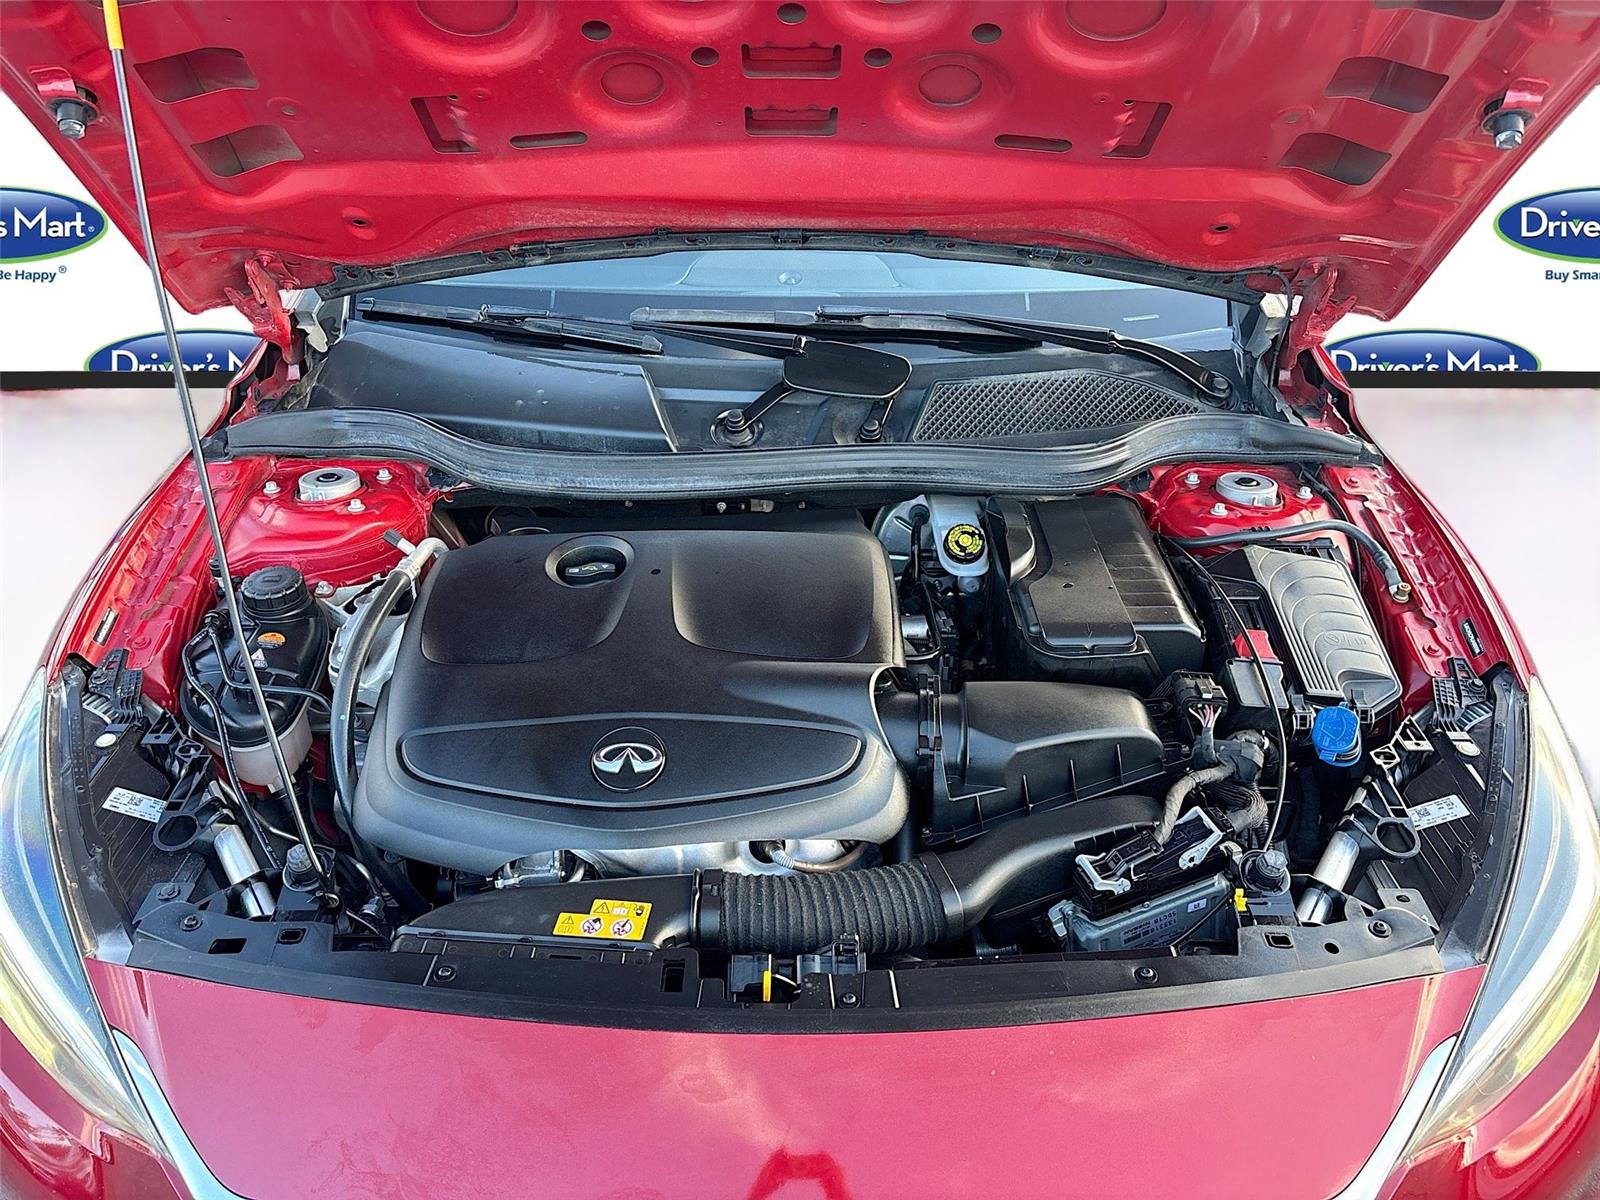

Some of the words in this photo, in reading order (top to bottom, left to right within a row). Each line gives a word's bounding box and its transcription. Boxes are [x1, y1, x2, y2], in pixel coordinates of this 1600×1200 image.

[14, 206, 86, 238] Mart
[1520, 206, 1600, 238] Drive
[1545, 269, 1570, 283] Buy
[1572, 269, 1600, 280] Sma
